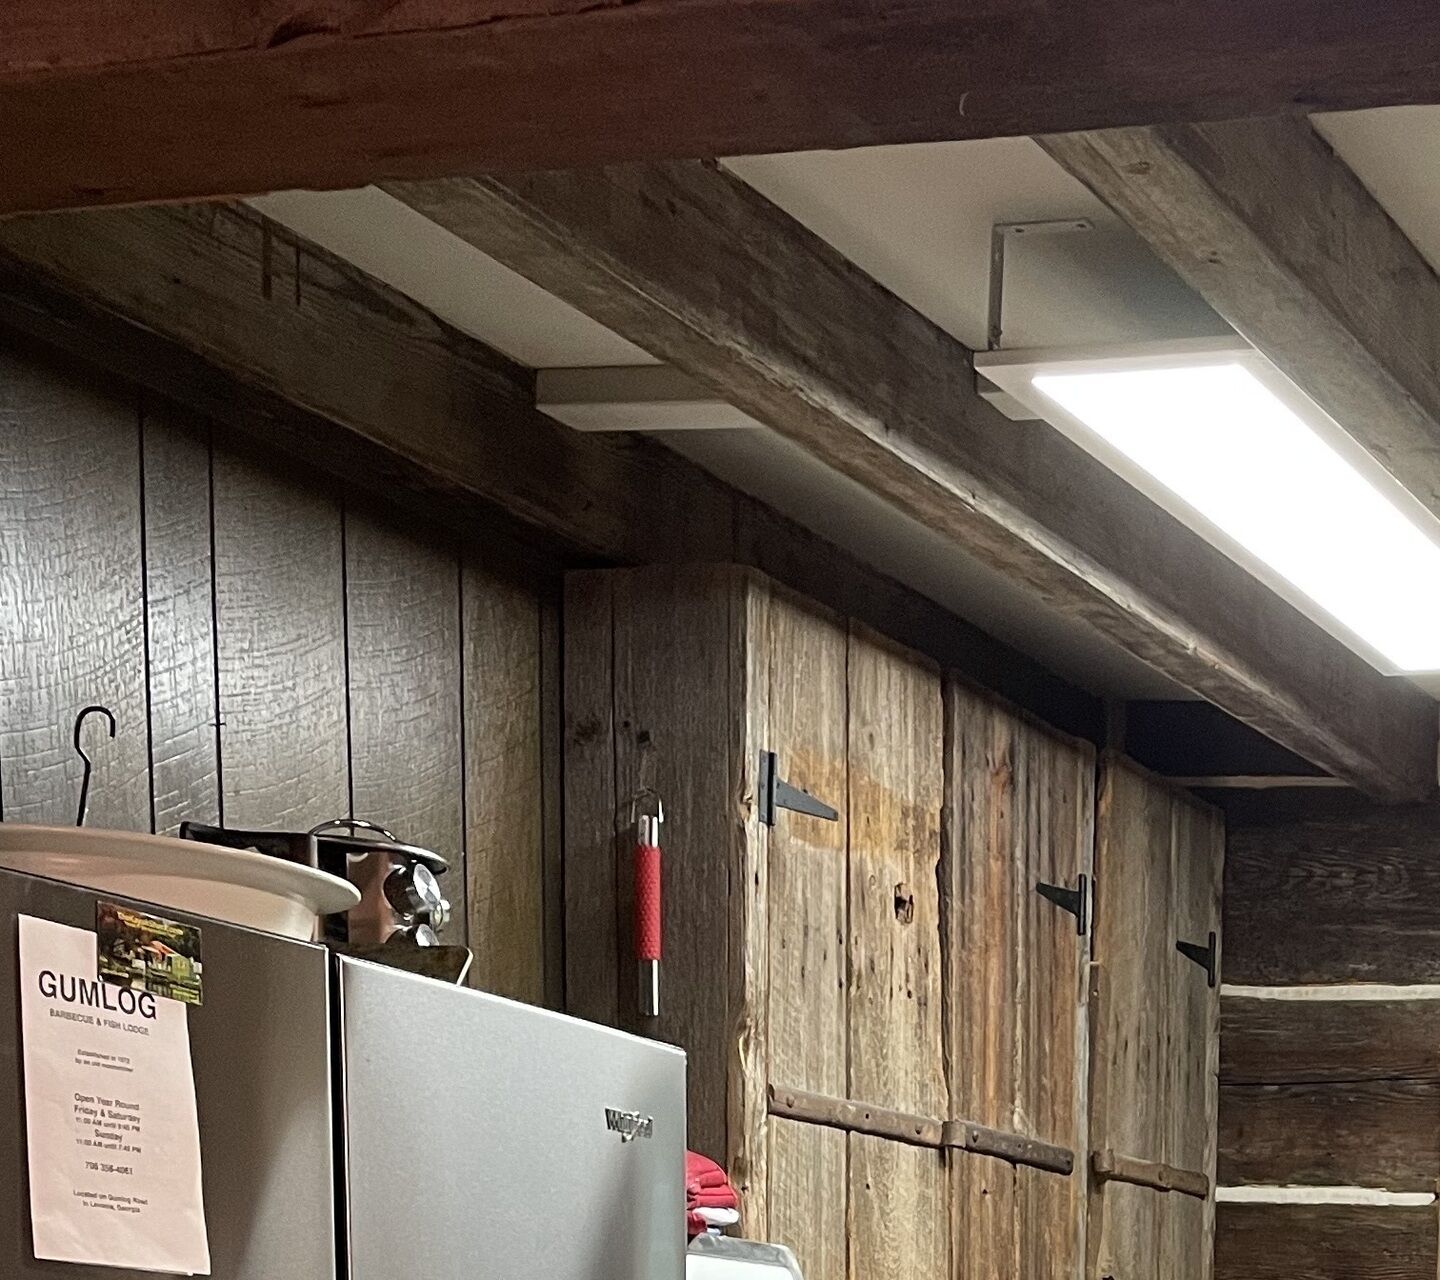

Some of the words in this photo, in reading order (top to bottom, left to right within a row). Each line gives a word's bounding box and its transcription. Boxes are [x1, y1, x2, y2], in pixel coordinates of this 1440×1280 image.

[38, 970, 157, 1020] GUMLOG
[49, 1008, 95, 1025] BARBECUE
[103, 1019, 121, 1031] FISH
[123, 1023, 150, 1036] LODGE
[74, 1093, 95, 1103] Open
[74, 1104, 98, 1118] Friday
[107, 1110, 140, 1124] Saturday
[94, 1128, 122, 1143] Sunday
